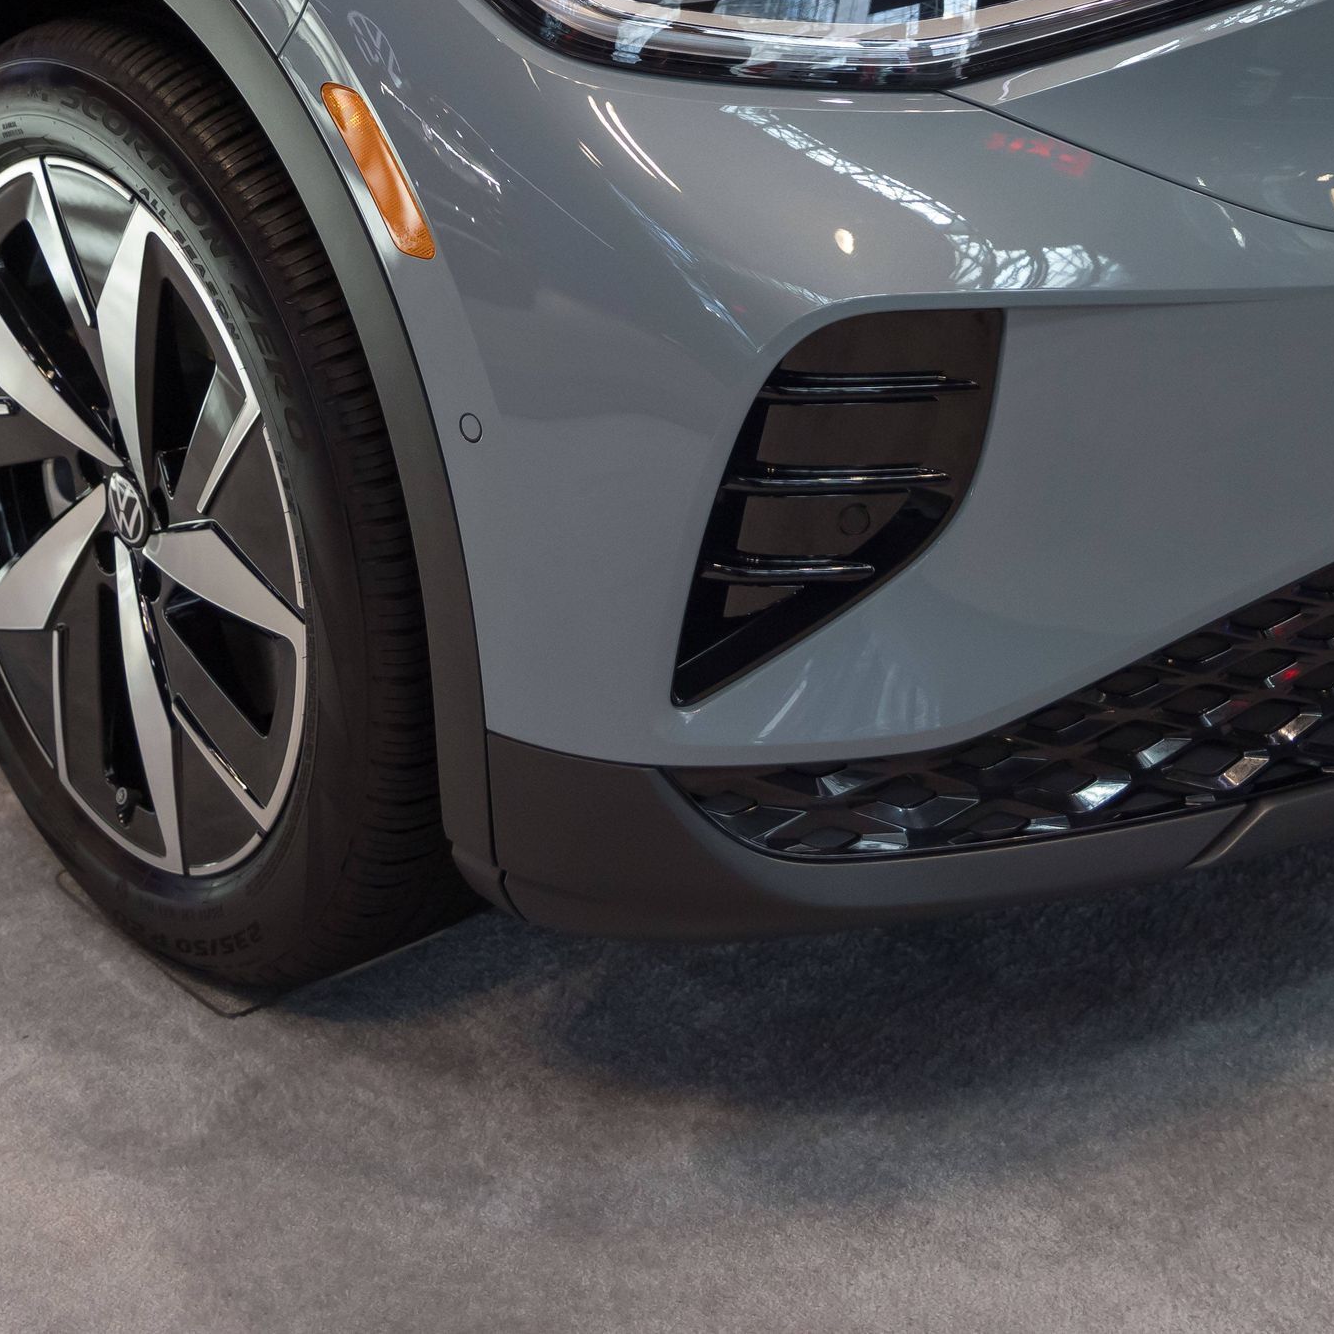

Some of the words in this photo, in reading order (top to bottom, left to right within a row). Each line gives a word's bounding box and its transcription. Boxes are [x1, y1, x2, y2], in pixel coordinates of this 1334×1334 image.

[60, 85, 229, 259] SCORPION
[138, 186, 167, 222] ALL
[173, 228, 241, 343] SEASON
